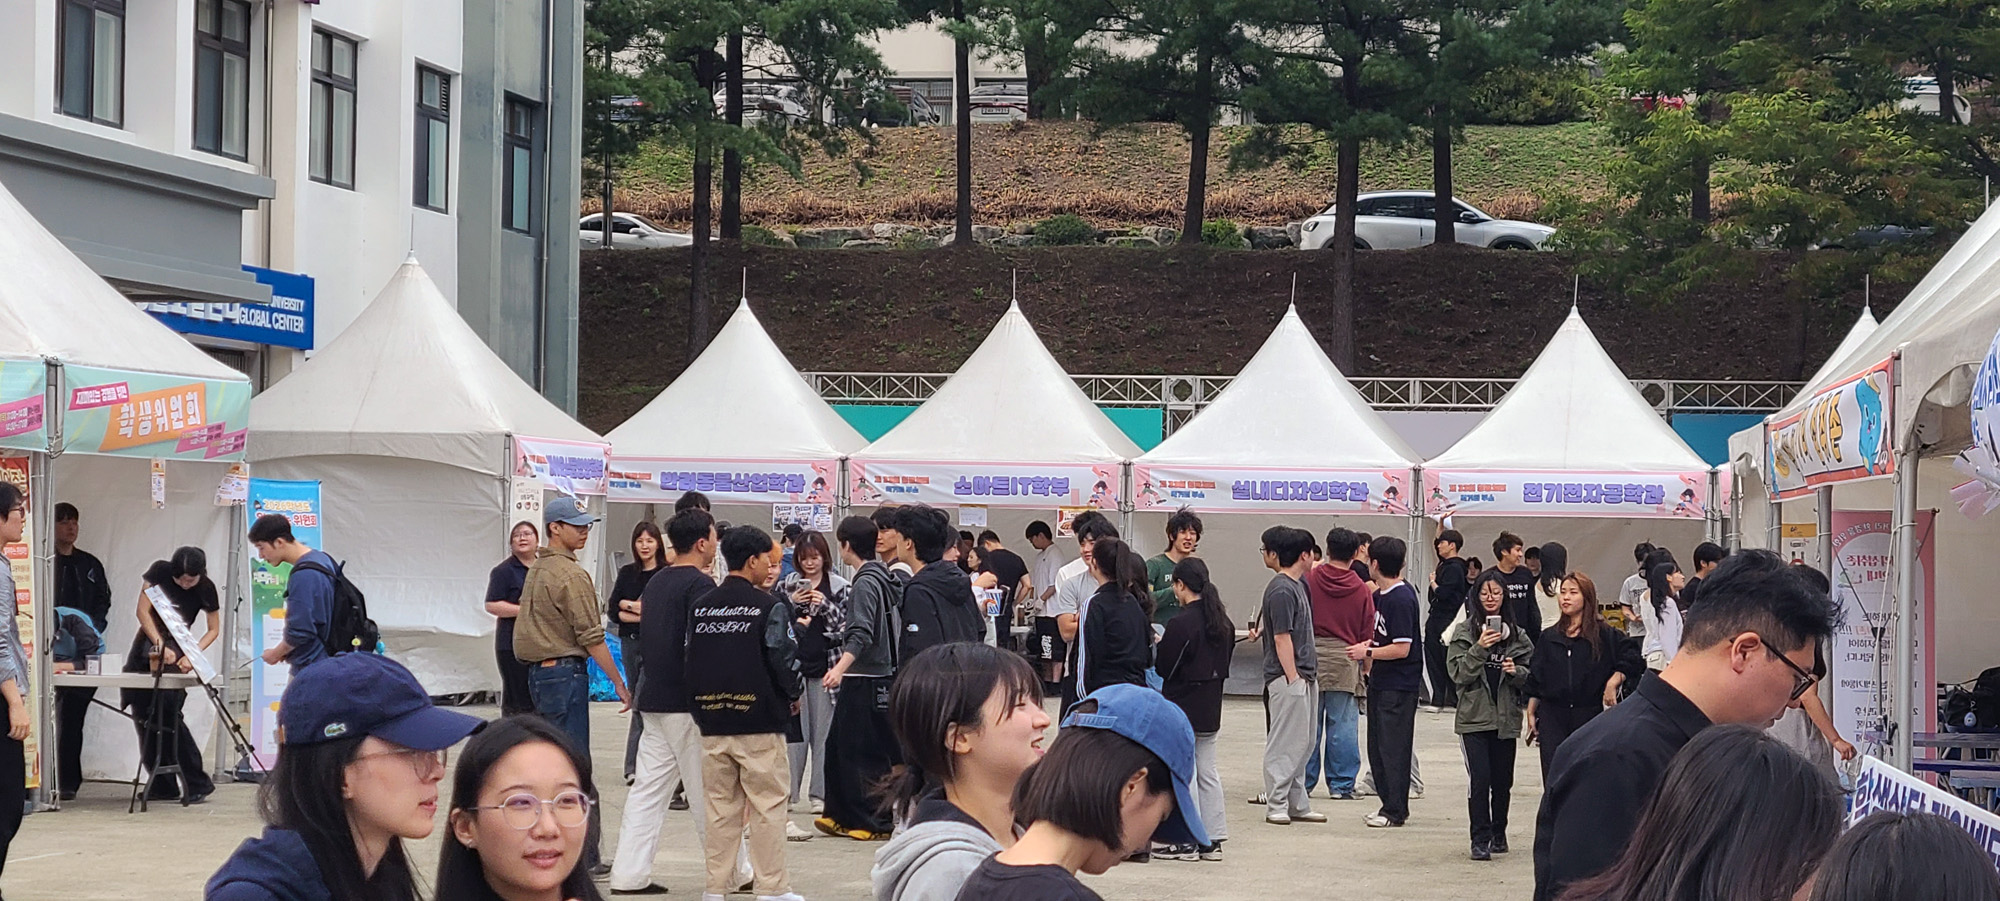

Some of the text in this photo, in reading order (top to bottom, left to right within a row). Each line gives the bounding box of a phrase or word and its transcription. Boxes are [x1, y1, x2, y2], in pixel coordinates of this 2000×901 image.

[239, 307, 271, 329] GLOBAL
[272, 315, 304, 333] CENTER
[117, 392, 201, 438] 학생위원회
[659, 471, 806, 493] 반려동물산업학과
[953, 475, 1070, 497] 스마트IT학부
[1231, 480, 1370, 502] 실내디자인학과
[1522, 482, 1666, 505] 전기전자공학과
[293, 514, 317, 527] 위원회
[695, 621, 751, 633] DESIGN
